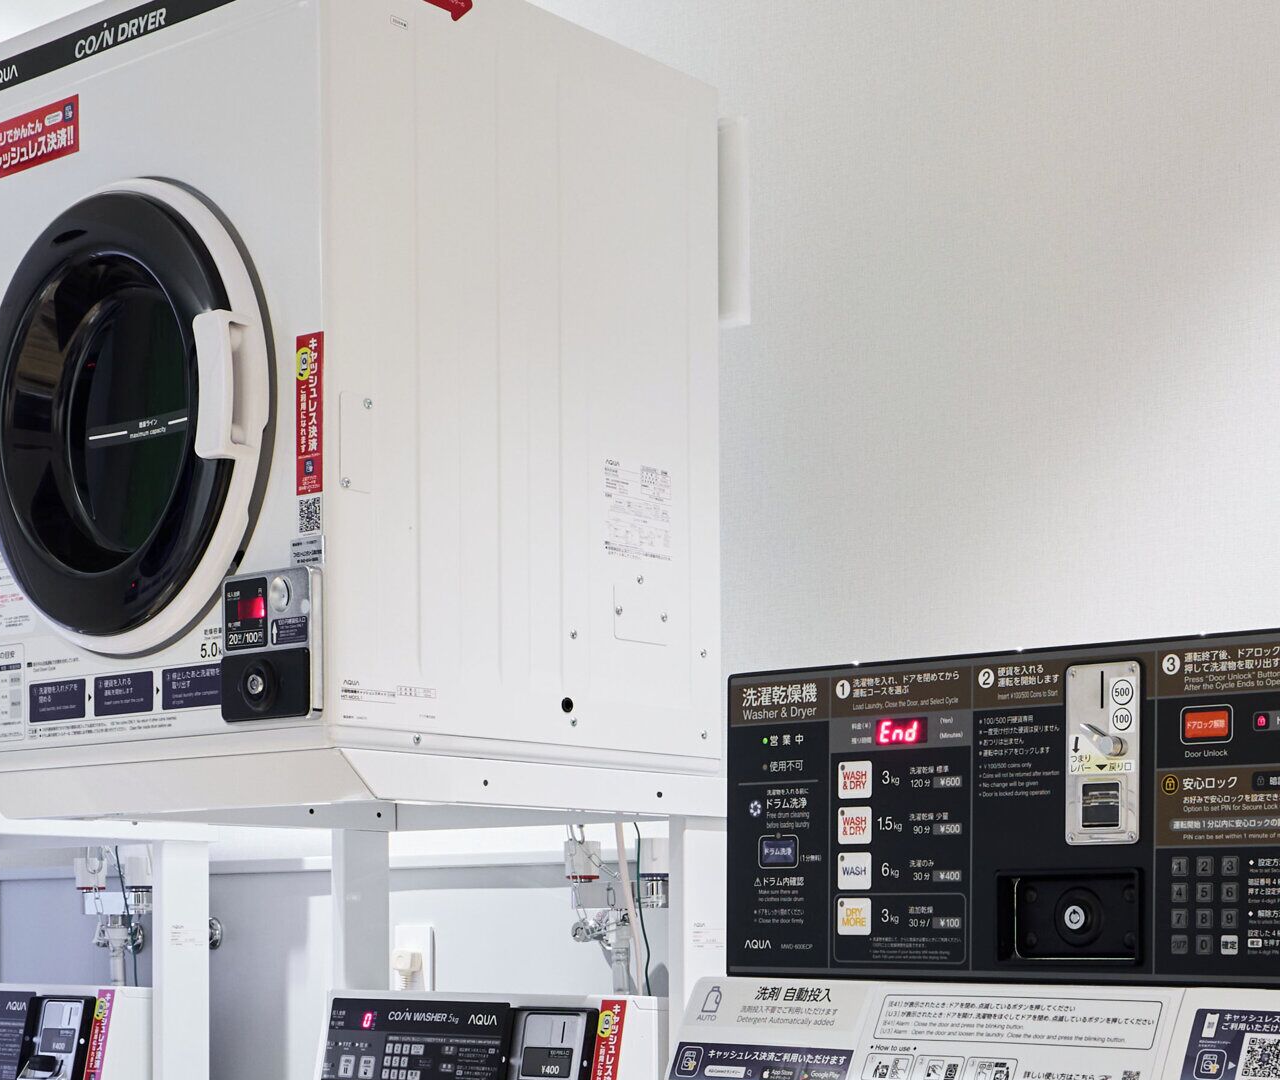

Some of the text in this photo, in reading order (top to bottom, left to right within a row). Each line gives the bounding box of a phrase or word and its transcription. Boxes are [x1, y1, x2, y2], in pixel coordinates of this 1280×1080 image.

[116, 8, 166, 42] DRYER
[308, 337, 318, 451] キャッシュレス決済
[998, 664, 1044, 676] 硬貨を入れる
[1184, 658, 1280, 674] 押して洗濯物を取り出す
[852, 672, 959, 687] 洗濯物を入れ、ドアを閉めてから
[998, 674, 1060, 688] 運転を開始します
[1216, 682, 1235, 690] Cycle
[1237, 680, 1255, 688] Ends
[742, 683, 817, 708] 洗濯乾燥機
[852, 685, 909, 698] 運転コースを選ぶ
[1114, 687, 1130, 698] 500
[743, 706, 816, 720] Washer & Dryer
[940, 717, 954, 725] (Yen)
[1114, 714, 1130, 724] 100
[1187, 720, 1226, 730] ドアロック解除
[879, 721, 918, 743] End
[940, 730, 964, 740] (Minutes)
[1070, 754, 1091, 763] つまり
[1184, 749, 1228, 758] Door Unlock
[770, 759, 804, 772] 使用不可
[910, 766, 934, 775] 洗濯乾燥
[1070, 764, 1091, 773] レバー
[1108, 763, 1132, 772] 戻り口
[843, 771, 867, 781] WASH
[842, 781, 866, 790] & DRY
[940, 777, 960, 786] ¥600
[1182, 776, 1238, 790] 安心ロック
[765, 798, 807, 809] ドラム洗浄
[843, 816, 866, 827] WASH
[909, 812, 949, 822] 洗濯乾燥 少量
[842, 826, 866, 836] & DRY
[913, 826, 930, 834] 90分
[940, 824, 960, 833] ¥500
[764, 848, 792, 856] ドラム洗浄
[909, 860, 934, 868] 洗濯のみ
[842, 866, 866, 876] WASH
[940, 872, 960, 880] ¥400
[762, 876, 804, 887] ドラム内確認
[913, 872, 930, 881] 30分
[846, 908, 863, 918] DRY
[908, 906, 934, 914] 追加乾燥
[842, 918, 866, 927] MORE
[940, 918, 960, 928] ¥100
[744, 940, 772, 950] AQUA
[754, 986, 832, 1002] 洗剤 自動投入
[6, 1001, 27, 1011] AQUA
[362, 1013, 372, 1028] 0
[413, 1012, 447, 1022] WASHER
[468, 1014, 497, 1026] AQUA
[696, 1014, 717, 1022] AUTO
[736, 1014, 836, 1027] Detergent Automatically added
[875, 1044, 887, 1052] How
[708, 1049, 847, 1066] キャッシュレス決済ご利用いただけます
[542, 1065, 560, 1075] ¥400
[810, 1070, 840, 1080] Google Play
